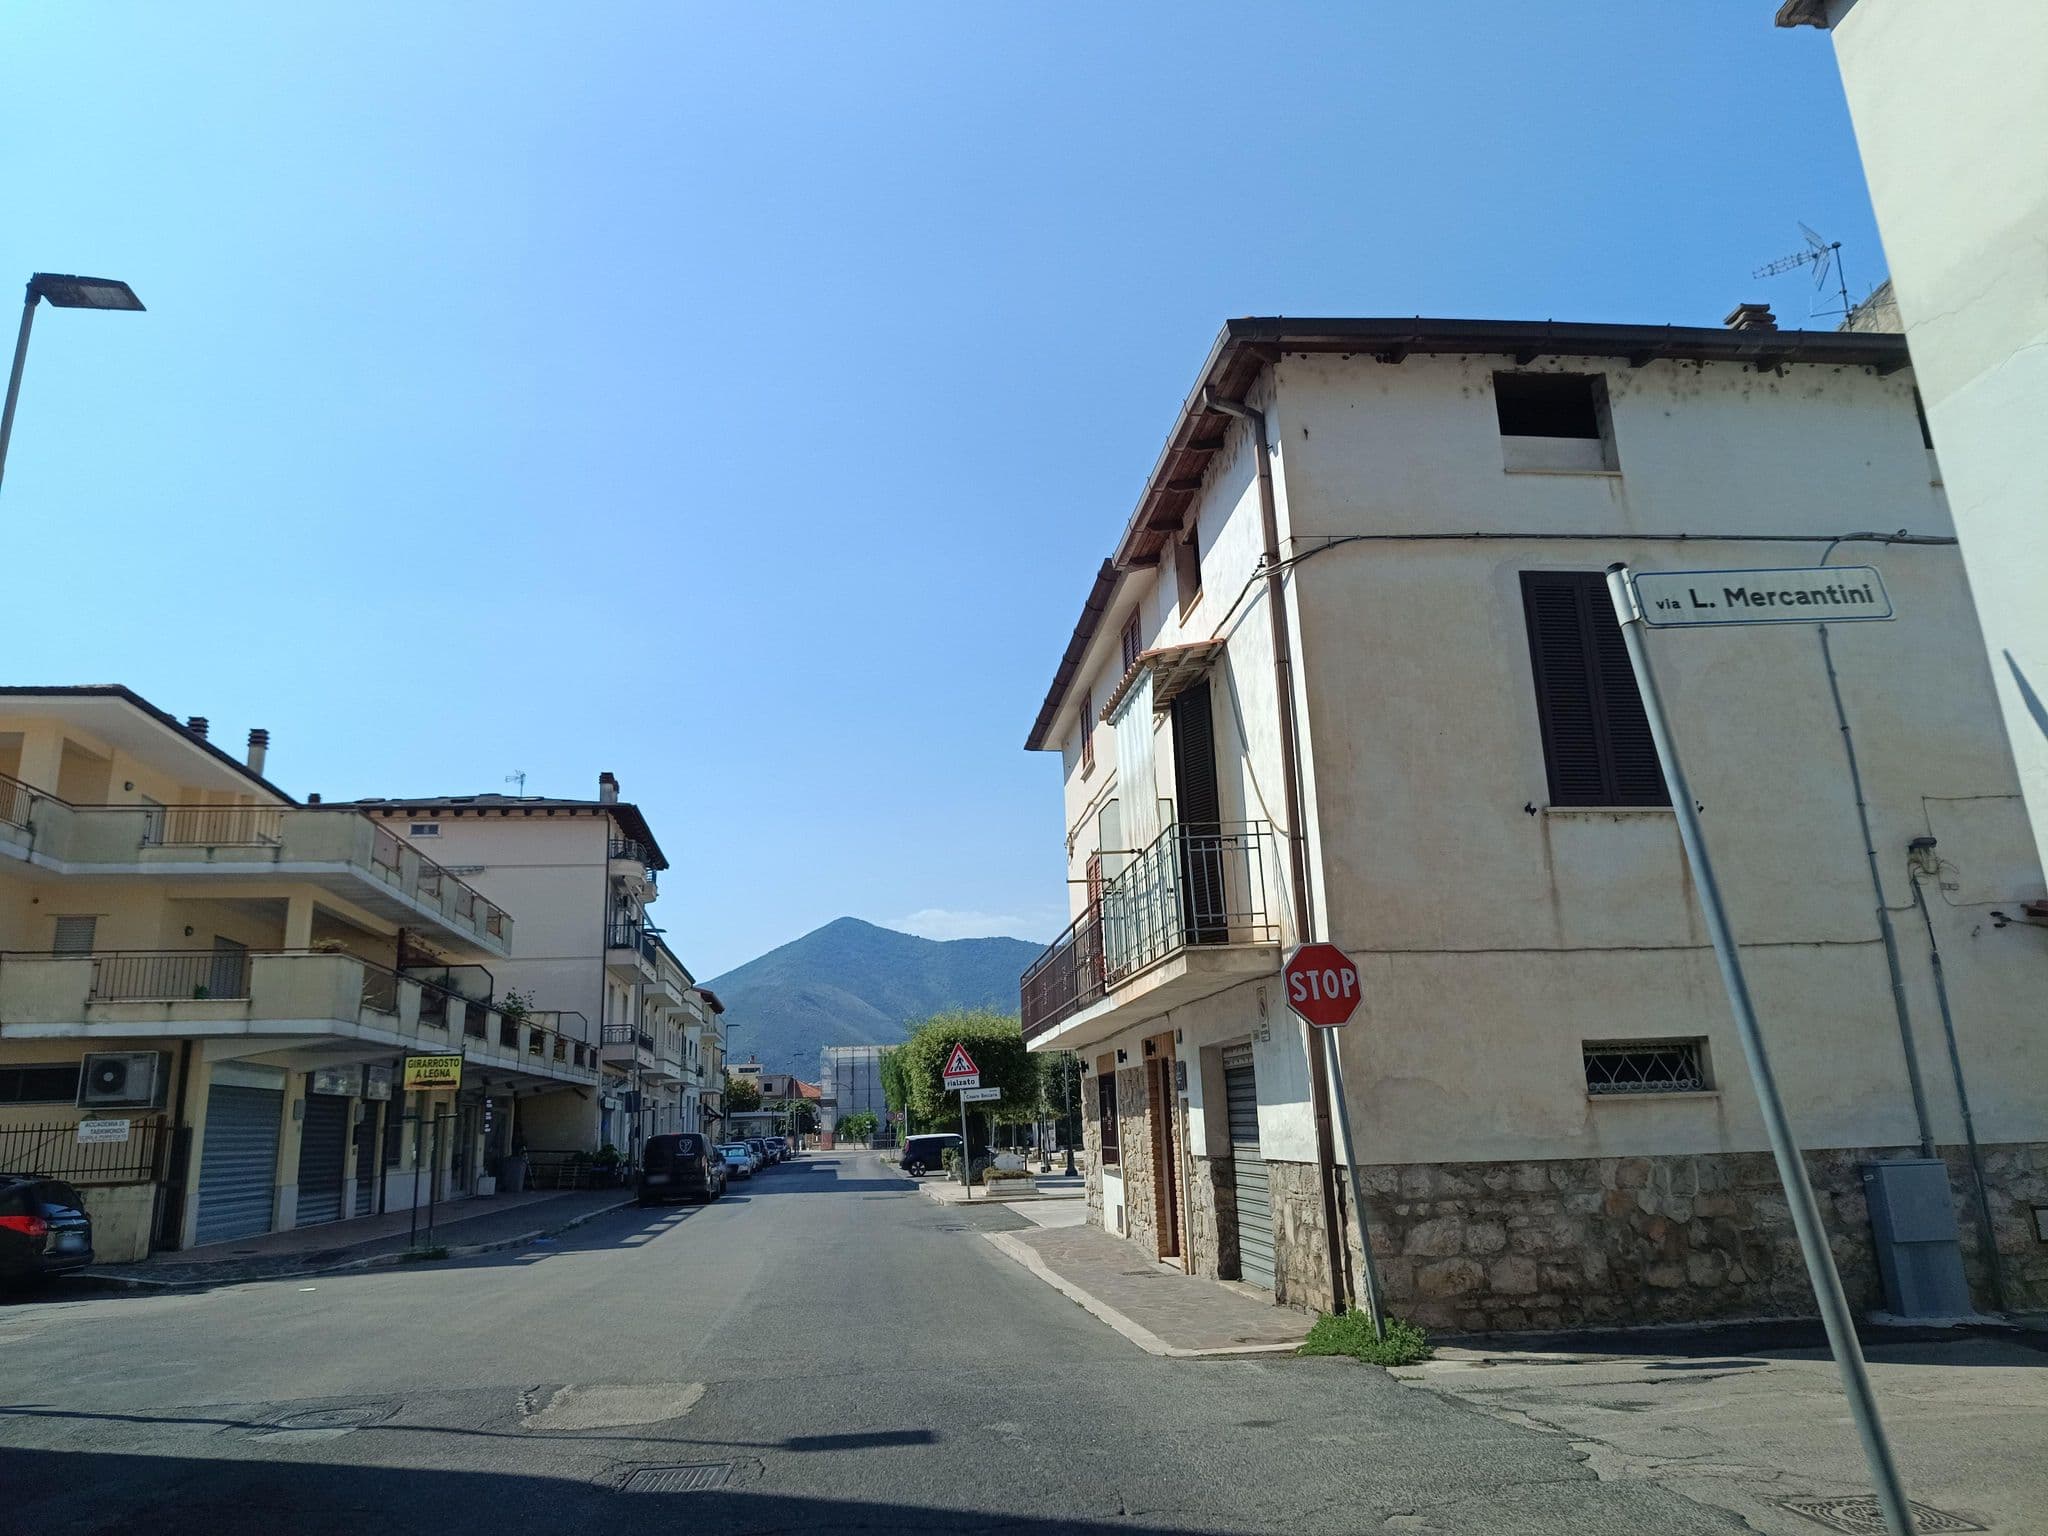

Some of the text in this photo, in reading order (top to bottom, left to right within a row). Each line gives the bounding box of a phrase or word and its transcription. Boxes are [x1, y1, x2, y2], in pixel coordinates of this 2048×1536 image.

[1655, 584, 1875, 610] via L. Mercantini
[1290, 967, 1355, 1002] STOP
[408, 1058, 460, 1068] GIRARROSTO
[416, 1069, 451, 1078] A LEGNA
[947, 1078, 976, 1087] rialzato
